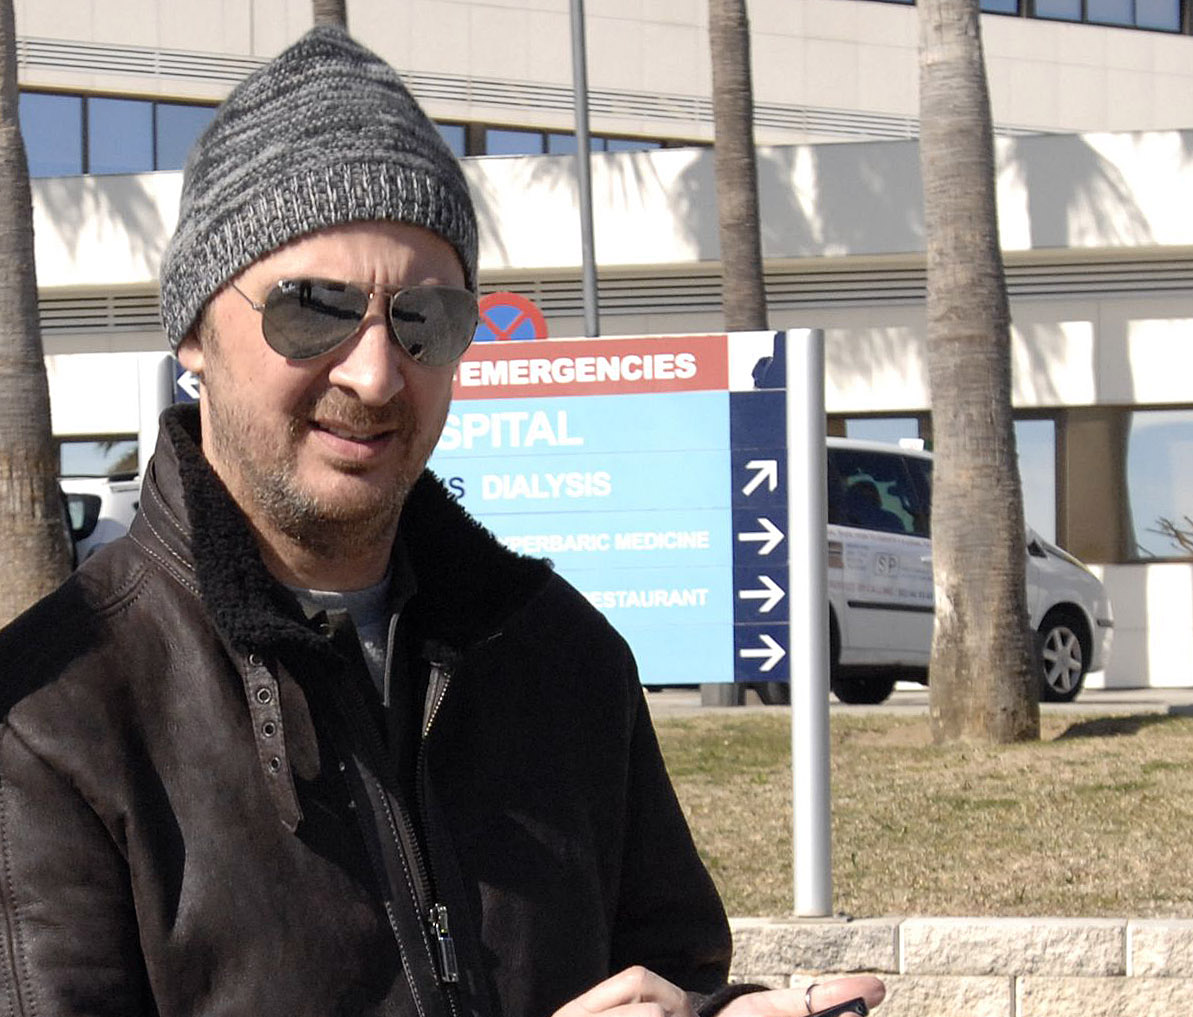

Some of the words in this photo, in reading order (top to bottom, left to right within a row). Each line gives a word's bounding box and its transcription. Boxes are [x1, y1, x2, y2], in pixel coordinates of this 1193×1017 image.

[460, 353, 696, 387] EMERGENCIES
[437, 409, 585, 451] SPITAL
[483, 472, 611, 500] DIALYSIS
[616, 530, 709, 551] MEDICINE
[580, 588, 709, 611] ESTAURANT
